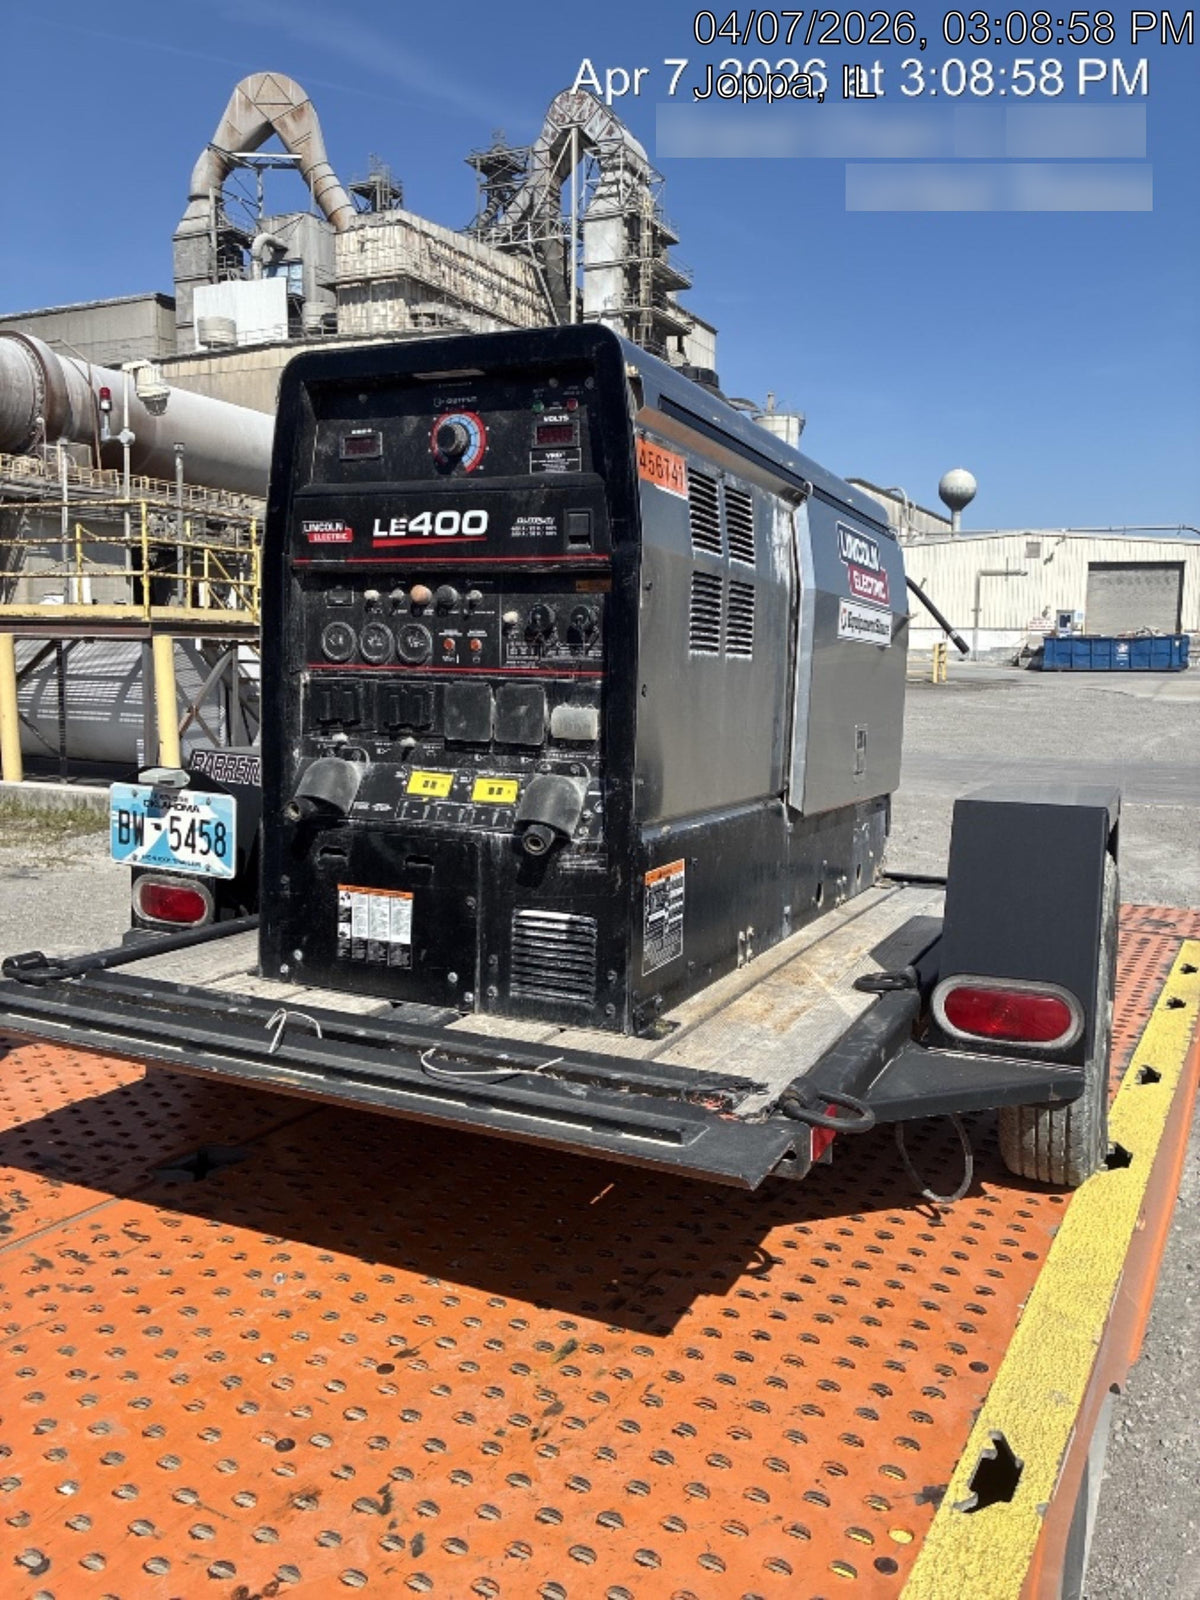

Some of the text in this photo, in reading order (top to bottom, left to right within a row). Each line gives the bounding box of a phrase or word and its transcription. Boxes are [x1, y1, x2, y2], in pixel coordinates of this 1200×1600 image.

[303, 522, 344, 533] LINCOLN
[373, 510, 488, 536] LE400
[313, 532, 348, 541] ELECTRIC
[840, 528, 880, 571] LINCOLN
[853, 570, 887, 599] ELECTRIC
[143, 800, 200, 814] OKLAHOMA
[118, 809, 226, 858] BW 5458
